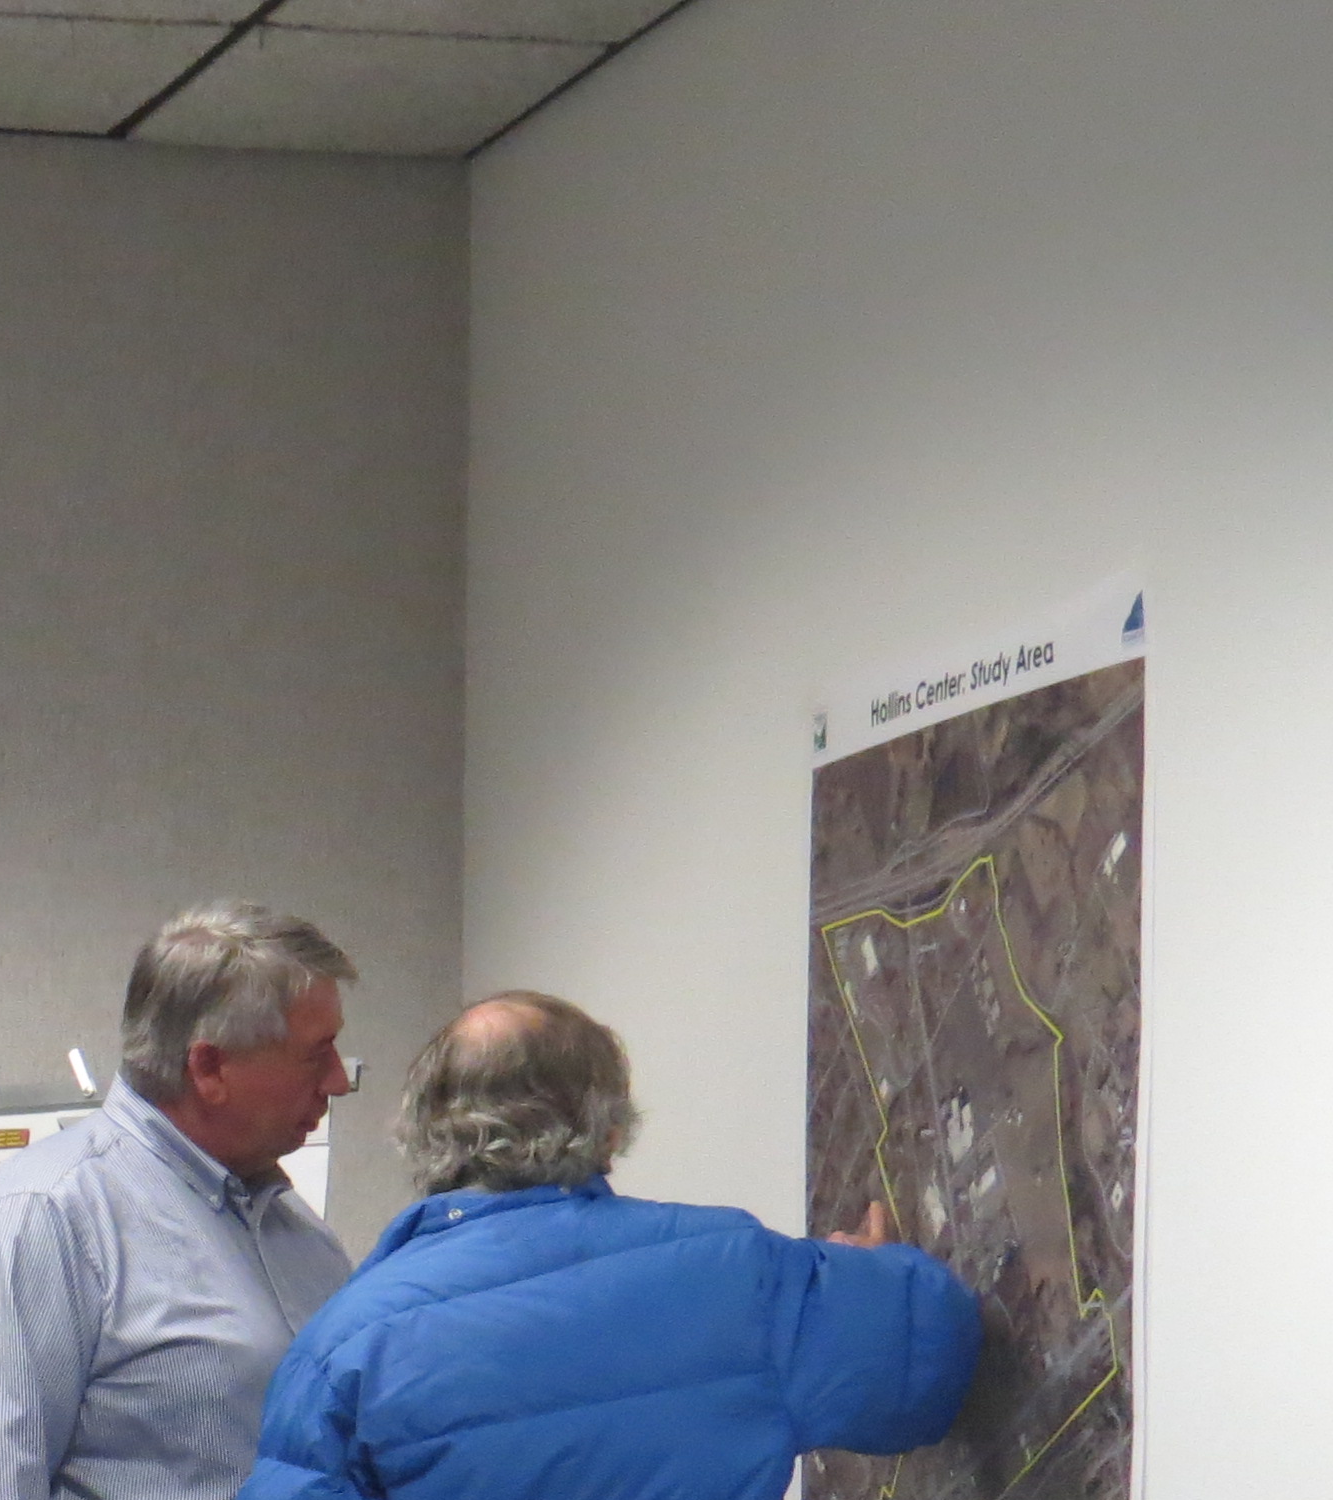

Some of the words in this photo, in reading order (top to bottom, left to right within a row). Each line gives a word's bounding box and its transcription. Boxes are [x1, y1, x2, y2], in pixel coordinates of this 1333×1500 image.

[871, 691, 912, 727] Hollins
[915, 672, 966, 710] Center:
[970, 652, 1011, 690] Study
[1016, 642, 1054, 674] Area
